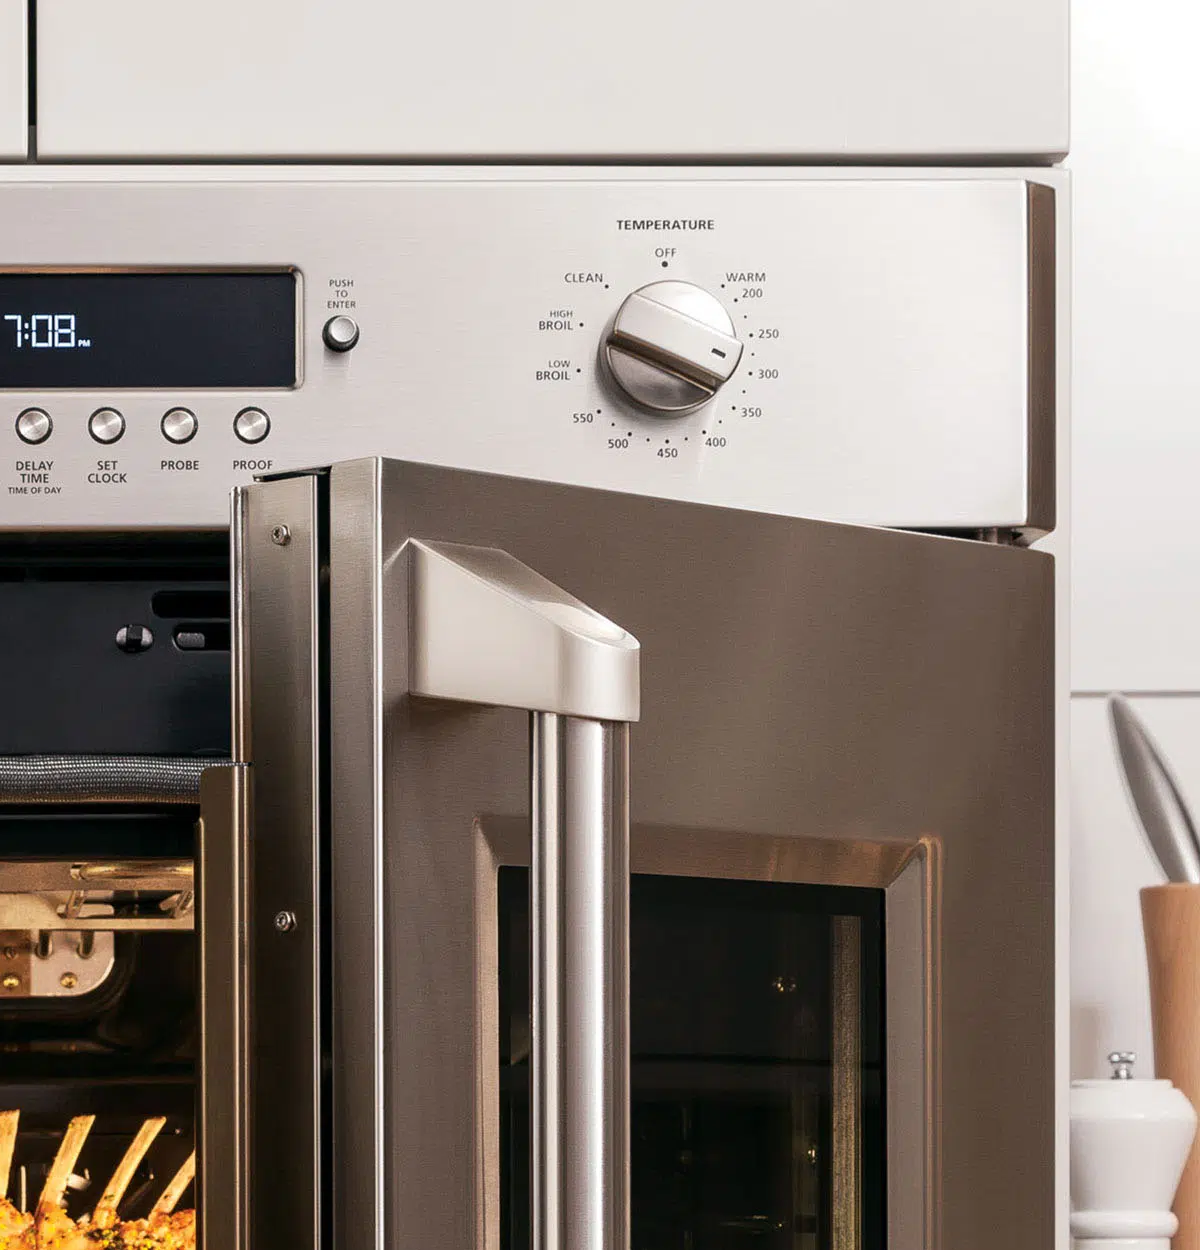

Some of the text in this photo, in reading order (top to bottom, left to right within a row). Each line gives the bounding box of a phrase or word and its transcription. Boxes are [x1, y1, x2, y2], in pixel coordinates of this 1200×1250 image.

[616, 219, 715, 231] TEMPERATURE
[654, 247, 676, 258] OFF
[328, 278, 354, 288] PUSH
[564, 272, 603, 284] CLEAN
[725, 272, 766, 283] WARM
[334, 289, 349, 299] TO
[741, 287, 763, 299] 200
[326, 300, 356, 309] ENTER
[549, 309, 574, 319] HIGH
[4, 314, 76, 348] 7:08
[538, 320, 574, 331] BROIL
[758, 328, 780, 339] 250
[548, 359, 571, 369] LOW
[535, 370, 570, 381] BROIL
[758, 368, 779, 380] 300
[572, 412, 594, 424] 550
[741, 407, 762, 418] 350
[607, 438, 629, 449] 500
[704, 436, 727, 448] 400
[656, 447, 679, 459] 450
[15, 460, 54, 472] DELAY
[96, 460, 119, 471] SET
[160, 459, 200, 471] PROBE
[232, 459, 273, 471] PROOF
[19, 473, 49, 484] TIME
[87, 472, 128, 484] CLOCK
[7, 486, 62, 495] TIME OF DAY
